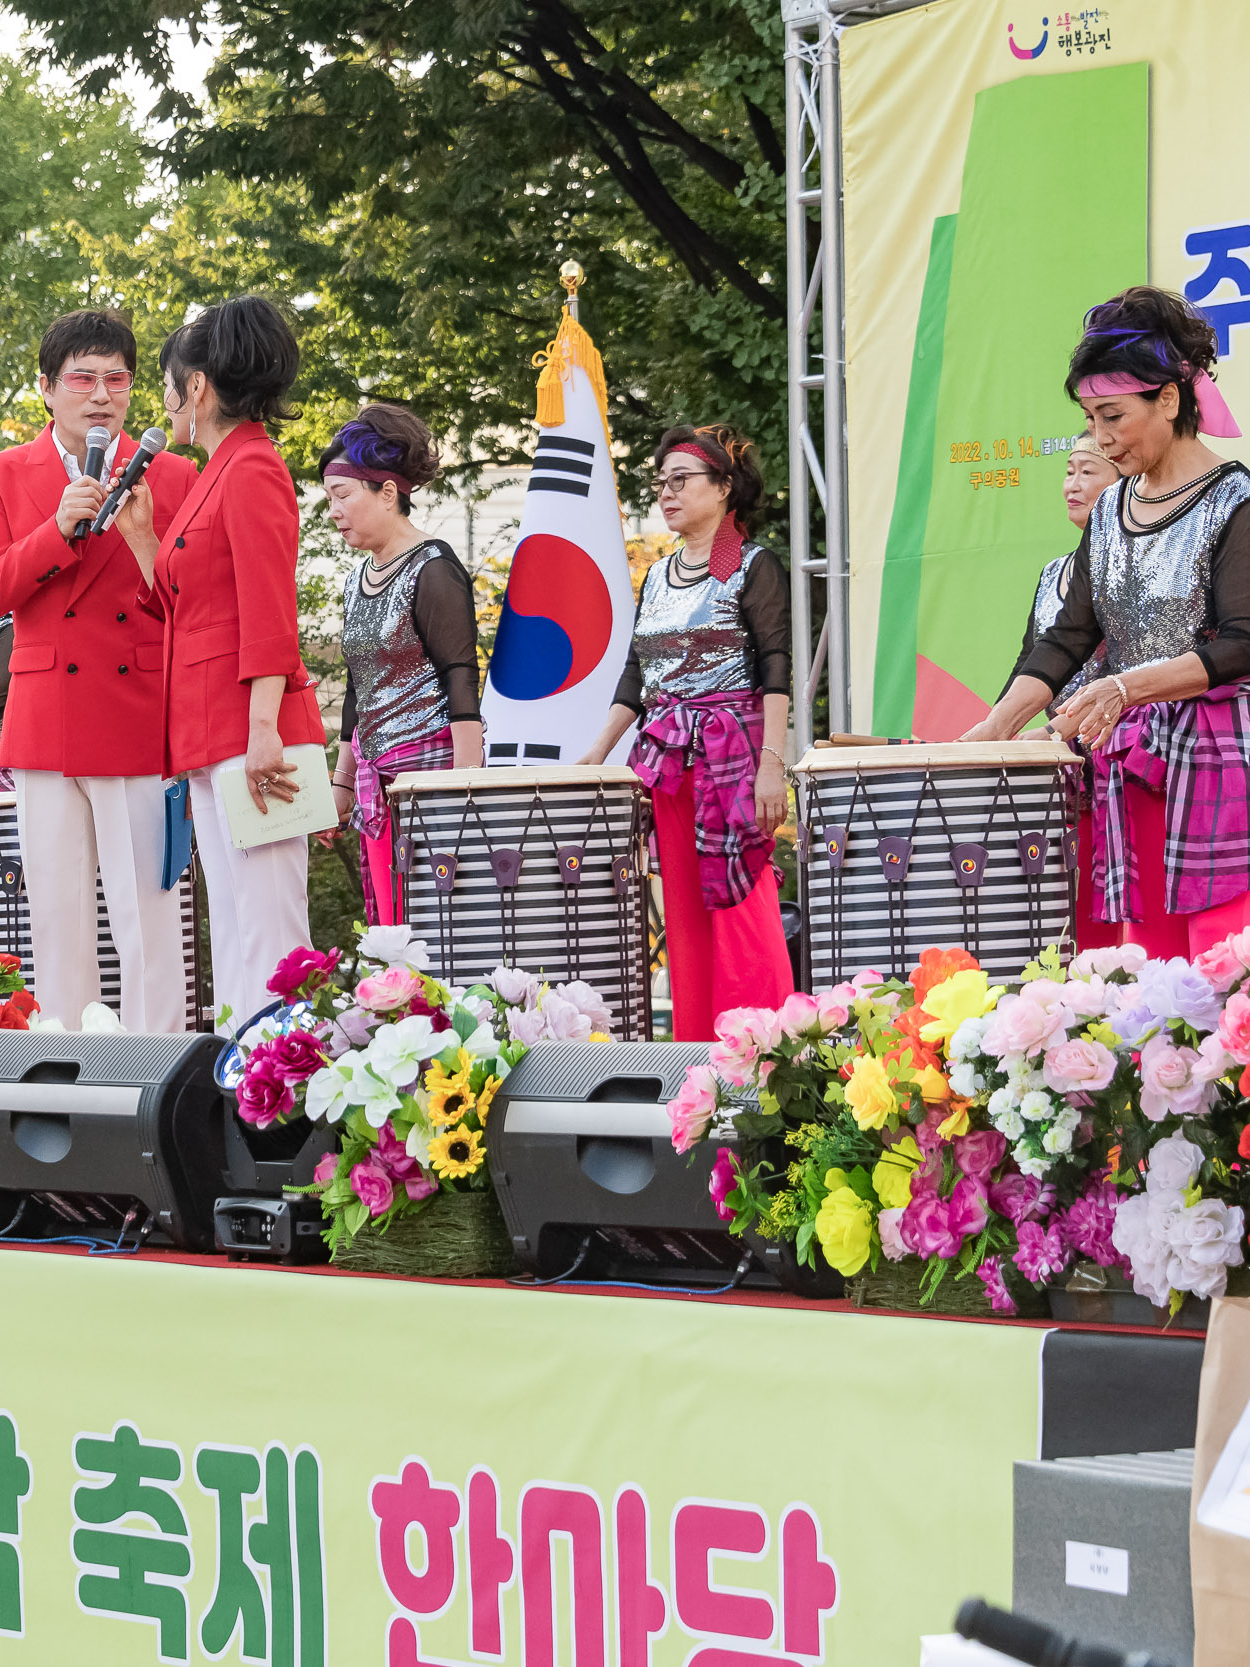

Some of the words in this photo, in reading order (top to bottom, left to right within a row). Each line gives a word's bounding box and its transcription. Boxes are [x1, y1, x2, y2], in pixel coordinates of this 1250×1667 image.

[1058, 28, 1111, 57] 행복광진
[993, 438, 1013, 460] 10.
[969, 467, 1020, 490] 구의공원
[71, 1420, 327, 1667] 축제
[370, 1456, 839, 1667] 한마당
